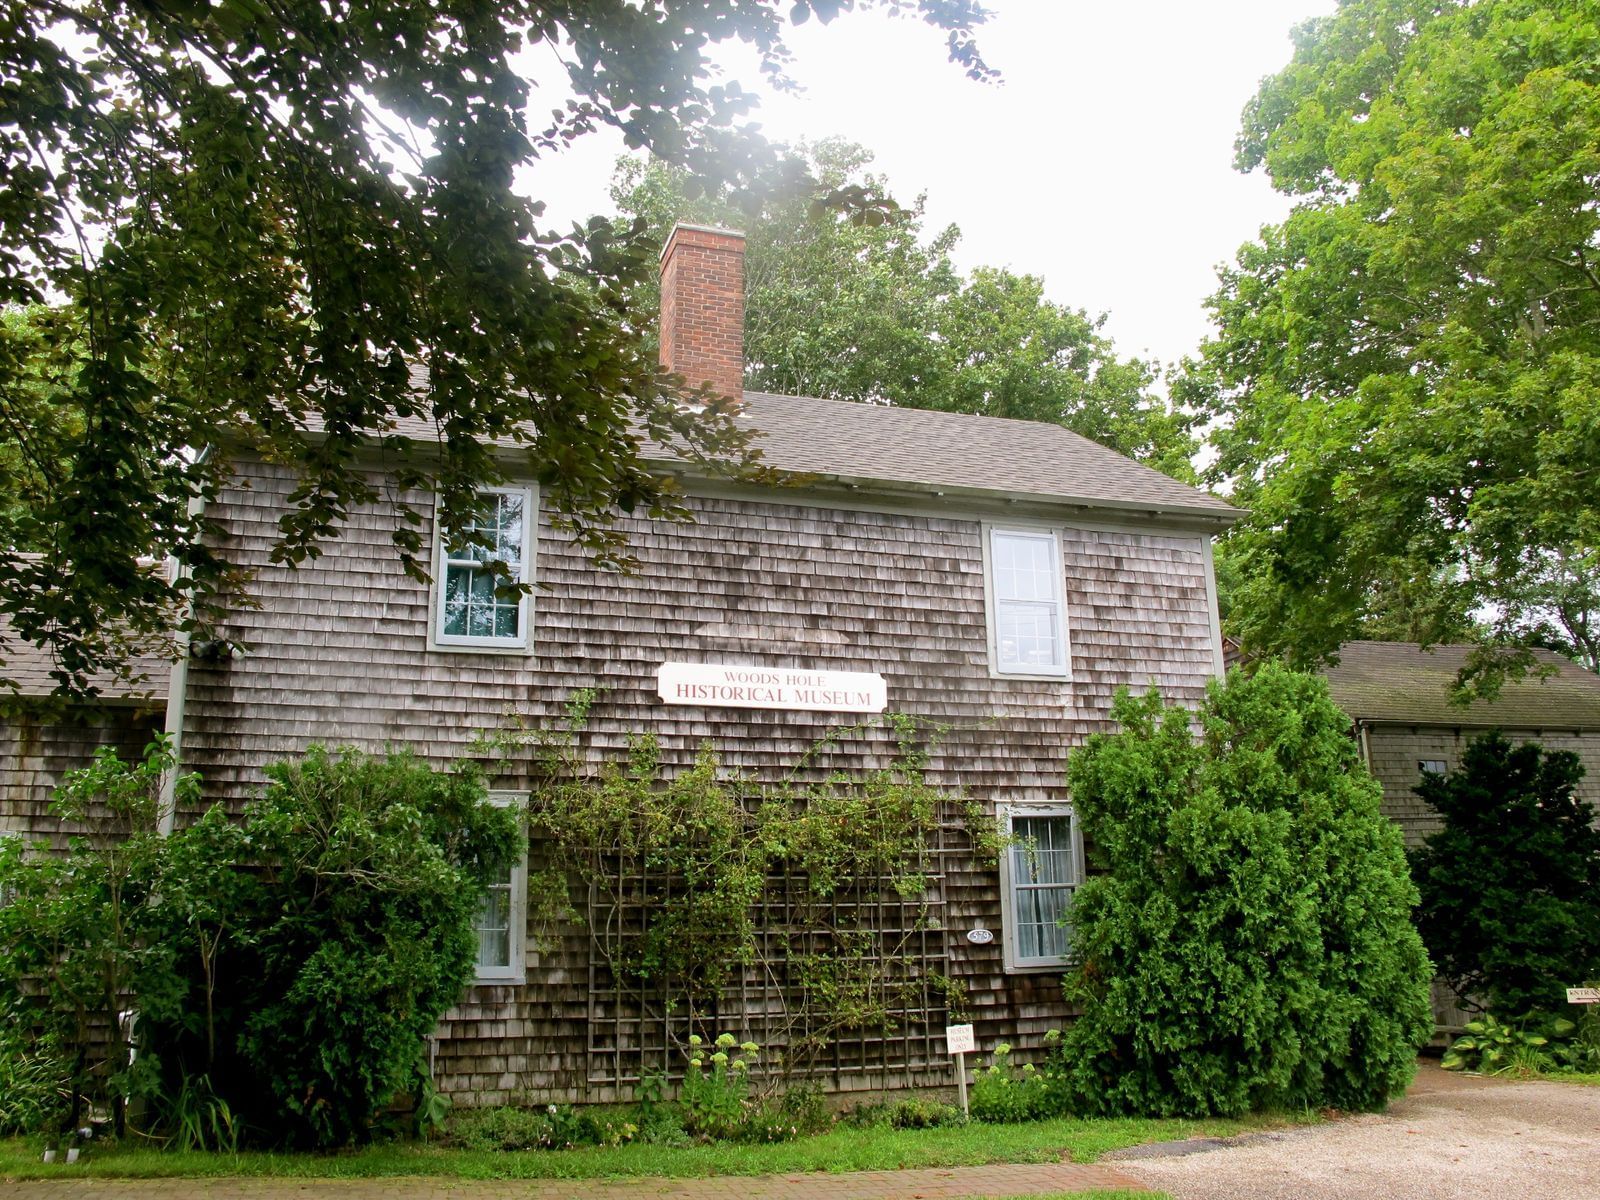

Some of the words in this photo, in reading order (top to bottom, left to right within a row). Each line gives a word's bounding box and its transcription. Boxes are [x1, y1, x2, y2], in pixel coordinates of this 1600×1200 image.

[724, 671, 780, 685] WOODS
[786, 675, 826, 687] HOLE
[676, 683, 787, 703] HISTORICAL
[794, 690, 871, 706] MUSEUM
